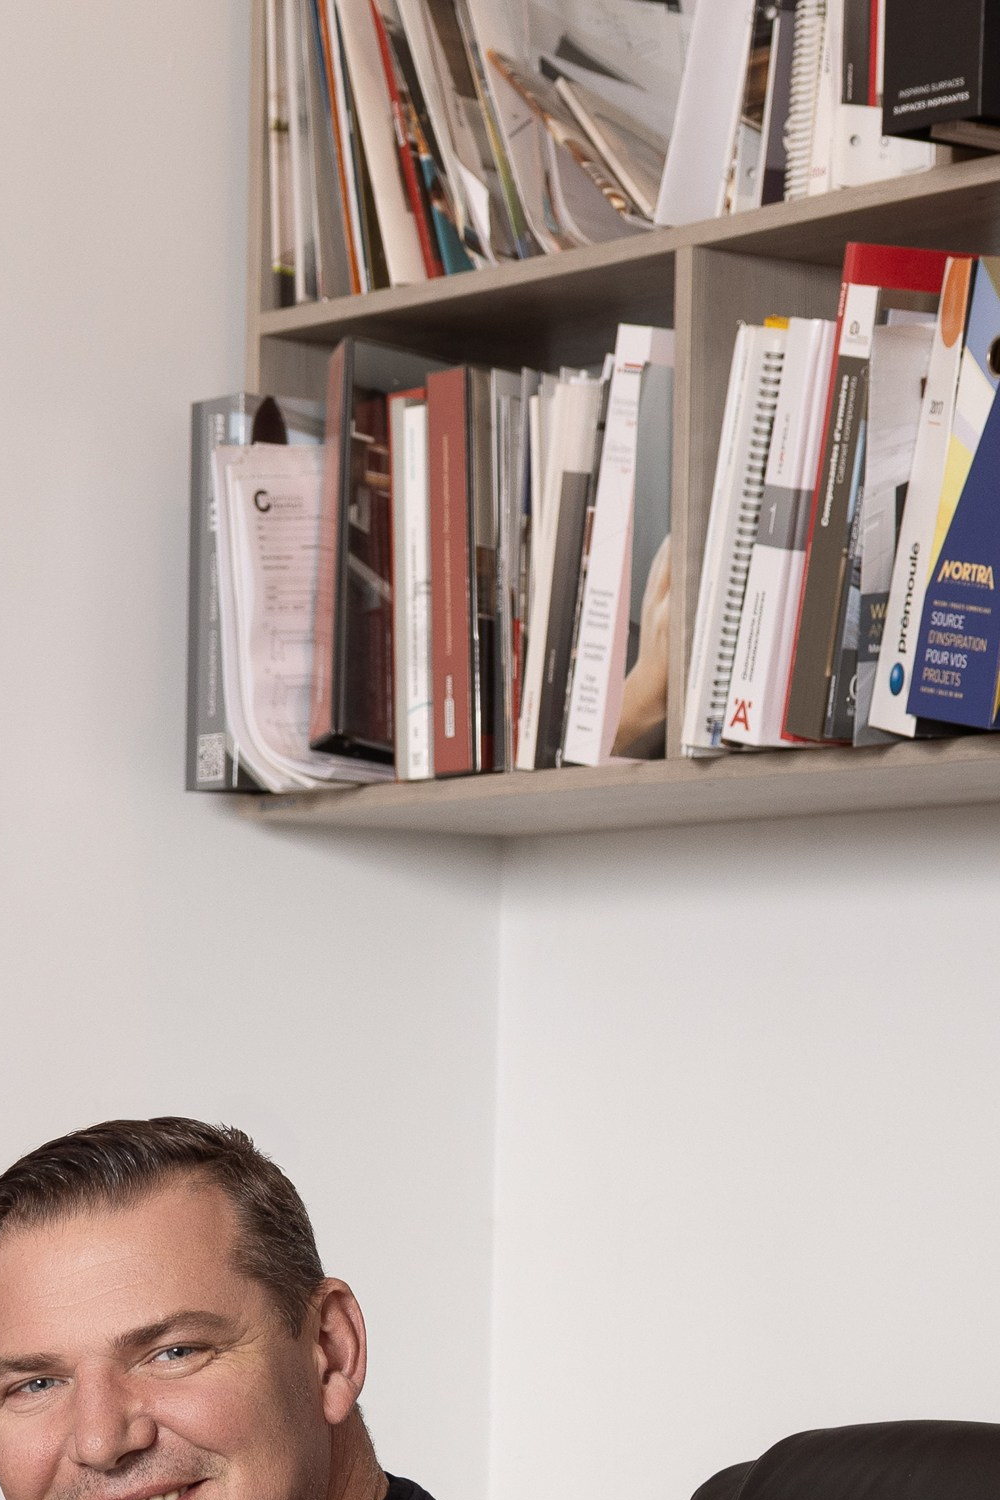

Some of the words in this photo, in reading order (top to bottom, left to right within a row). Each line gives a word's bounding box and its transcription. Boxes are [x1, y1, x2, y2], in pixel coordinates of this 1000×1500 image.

[931, 77, 966, 92] SURFACES
[892, 100, 927, 115] SURFACES
[930, 610, 966, 630] SOURCE
[927, 629, 988, 653] D'INSPIRATION
[924, 648, 949, 666] POUR
[949, 652, 969, 669] VOS
[921, 666, 962, 688] PROJETS
